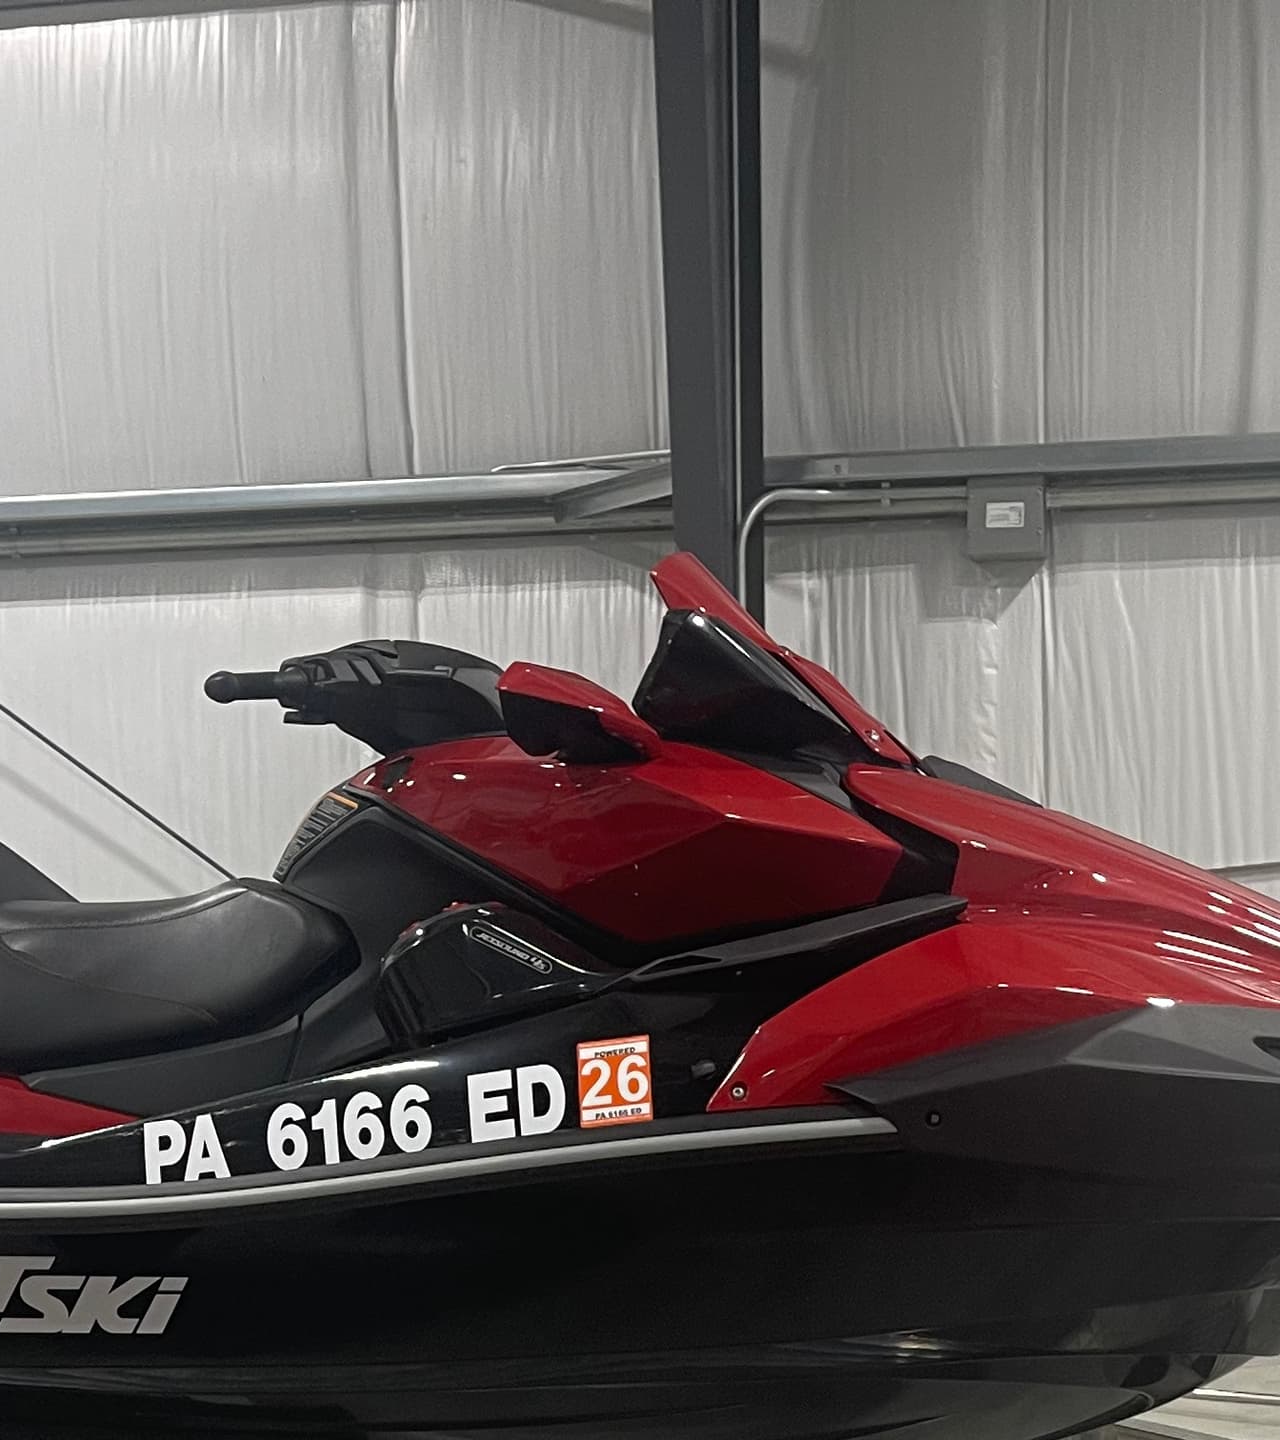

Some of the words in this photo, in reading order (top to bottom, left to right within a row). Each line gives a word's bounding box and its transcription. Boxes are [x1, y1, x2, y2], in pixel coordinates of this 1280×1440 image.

[594, 1046, 636, 1058] POWERED
[581, 1054, 649, 1107] 26
[143, 1113, 231, 1185] PA
[267, 1084, 433, 1171] 6166
[467, 1064, 566, 1143] ED
[595, 1112, 606, 1120] PA
[630, 1107, 642, 1115] ED
